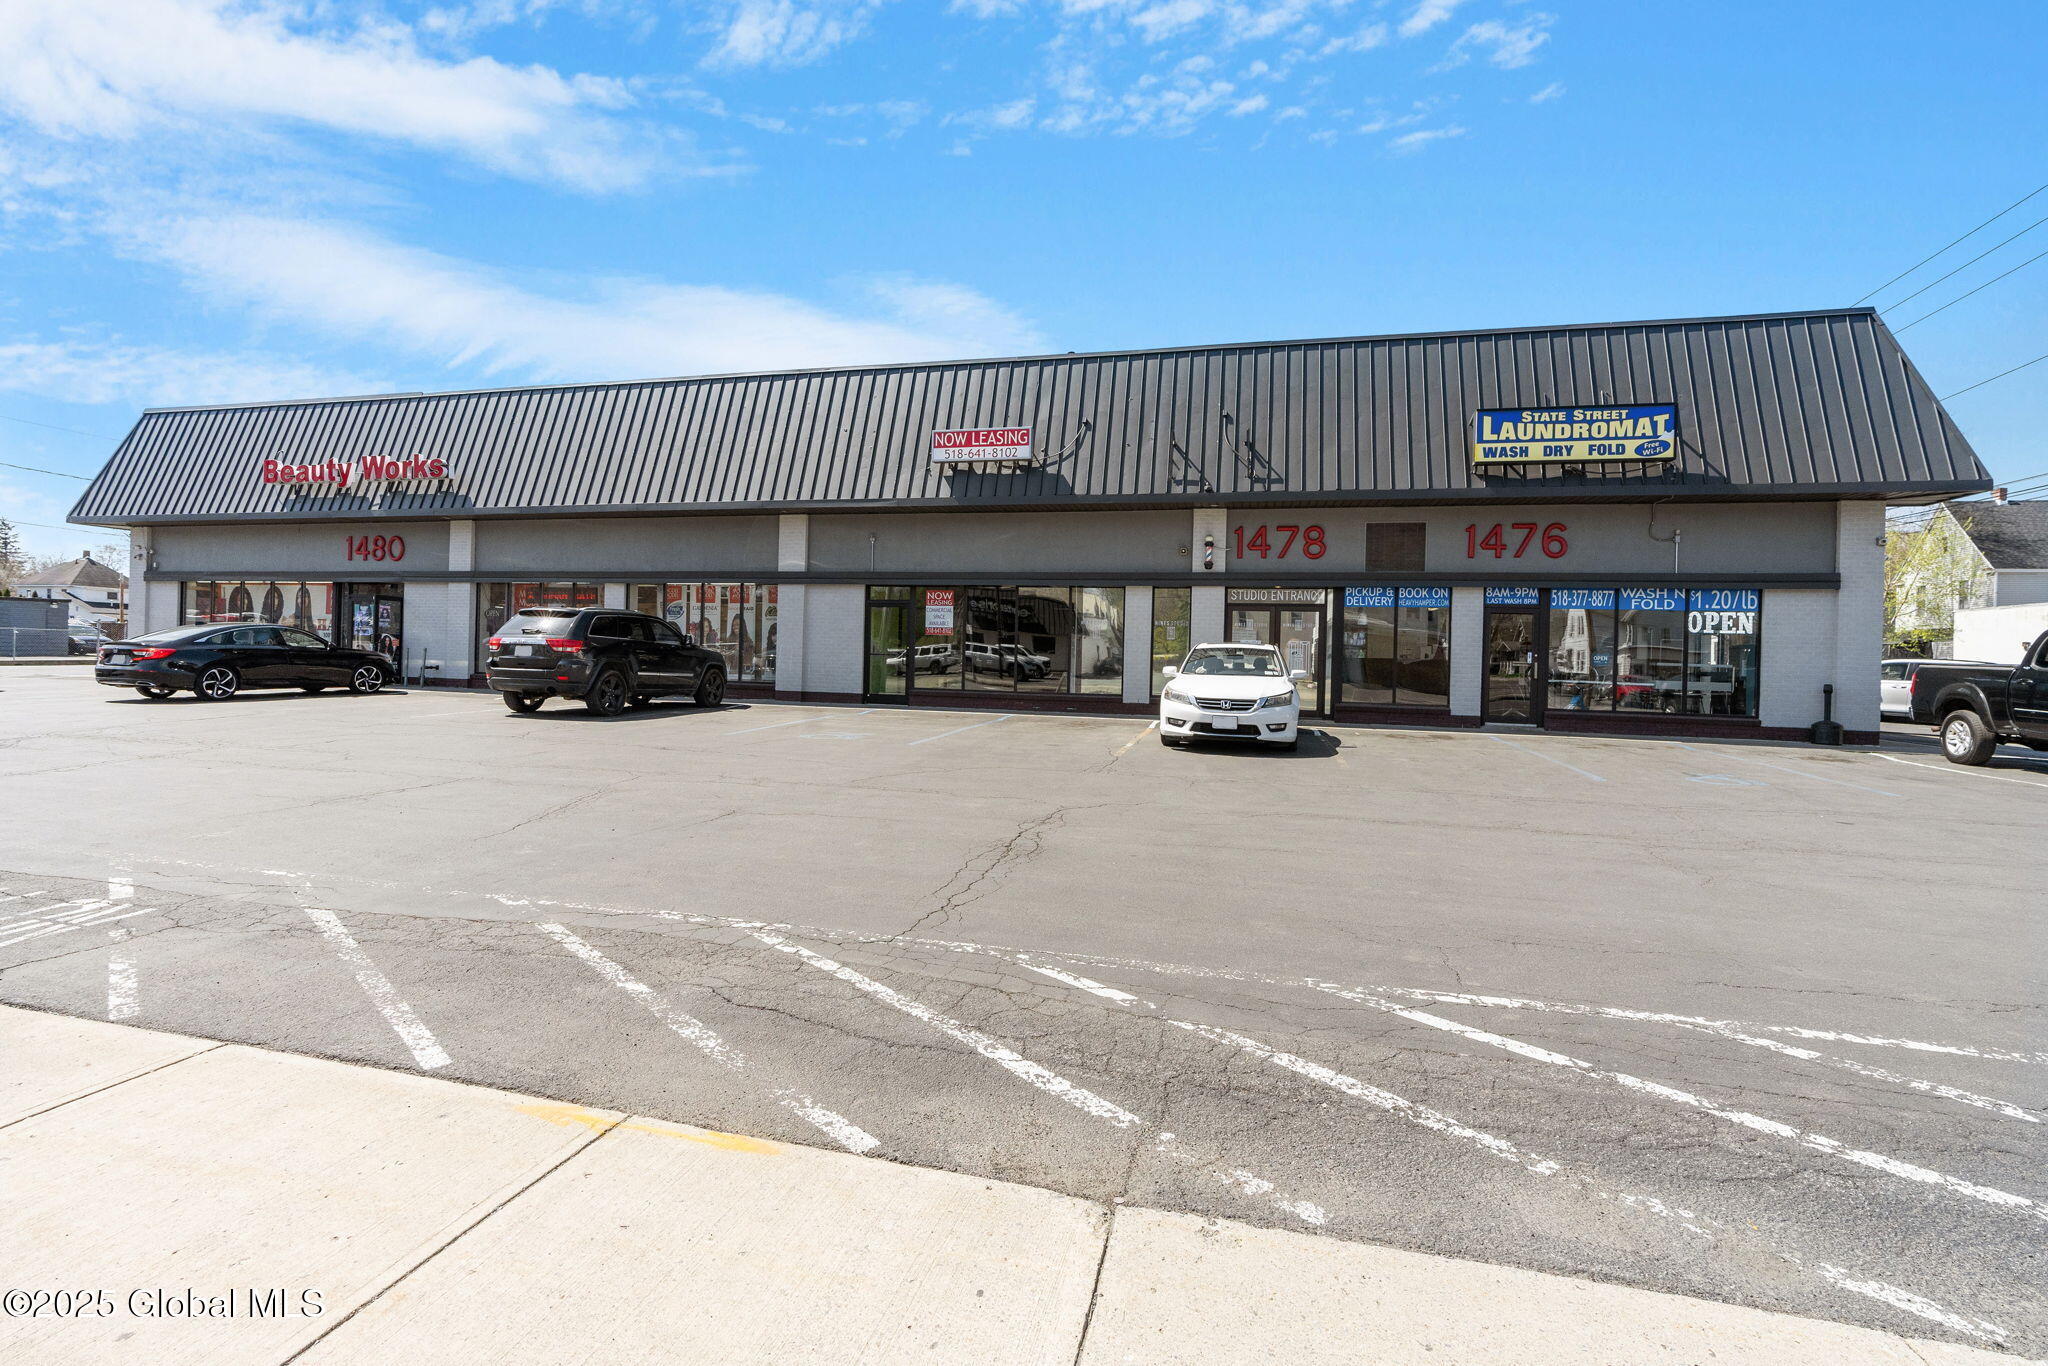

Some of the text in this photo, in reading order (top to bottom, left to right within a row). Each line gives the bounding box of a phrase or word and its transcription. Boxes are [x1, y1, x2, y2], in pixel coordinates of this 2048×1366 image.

[1522, 409, 1629, 423] STATE STREET
[1483, 414, 1670, 441] LAUNDROMAT
[935, 430, 1028, 446] NOW LEASING
[944, 447, 1018, 459] 518-641-8102
[1483, 444, 1626, 458] WASH DRY FOLD
[263, 453, 444, 488] Beauty Works
[1234, 525, 1327, 559] 1478
[1465, 523, 1568, 559] 1476
[346, 535, 406, 562] 1480
[927, 592, 953, 600] NOW
[1231, 590, 1267, 601] STUDIO
[1345, 588, 1394, 597] PICKUP &
[1399, 588, 1448, 598] BOOK ON
[1486, 587, 1539, 597] 8AM-9PM
[1551, 590, 1614, 607] 518-377-8877
[1621, 588, 1686, 599] WASH N
[1346, 597, 1393, 606] DELIVERY
[1631, 599, 1675, 610] FOLD
[1690, 590, 1758, 610] $1.20/lb
[1688, 611, 1755, 634] OPEN
